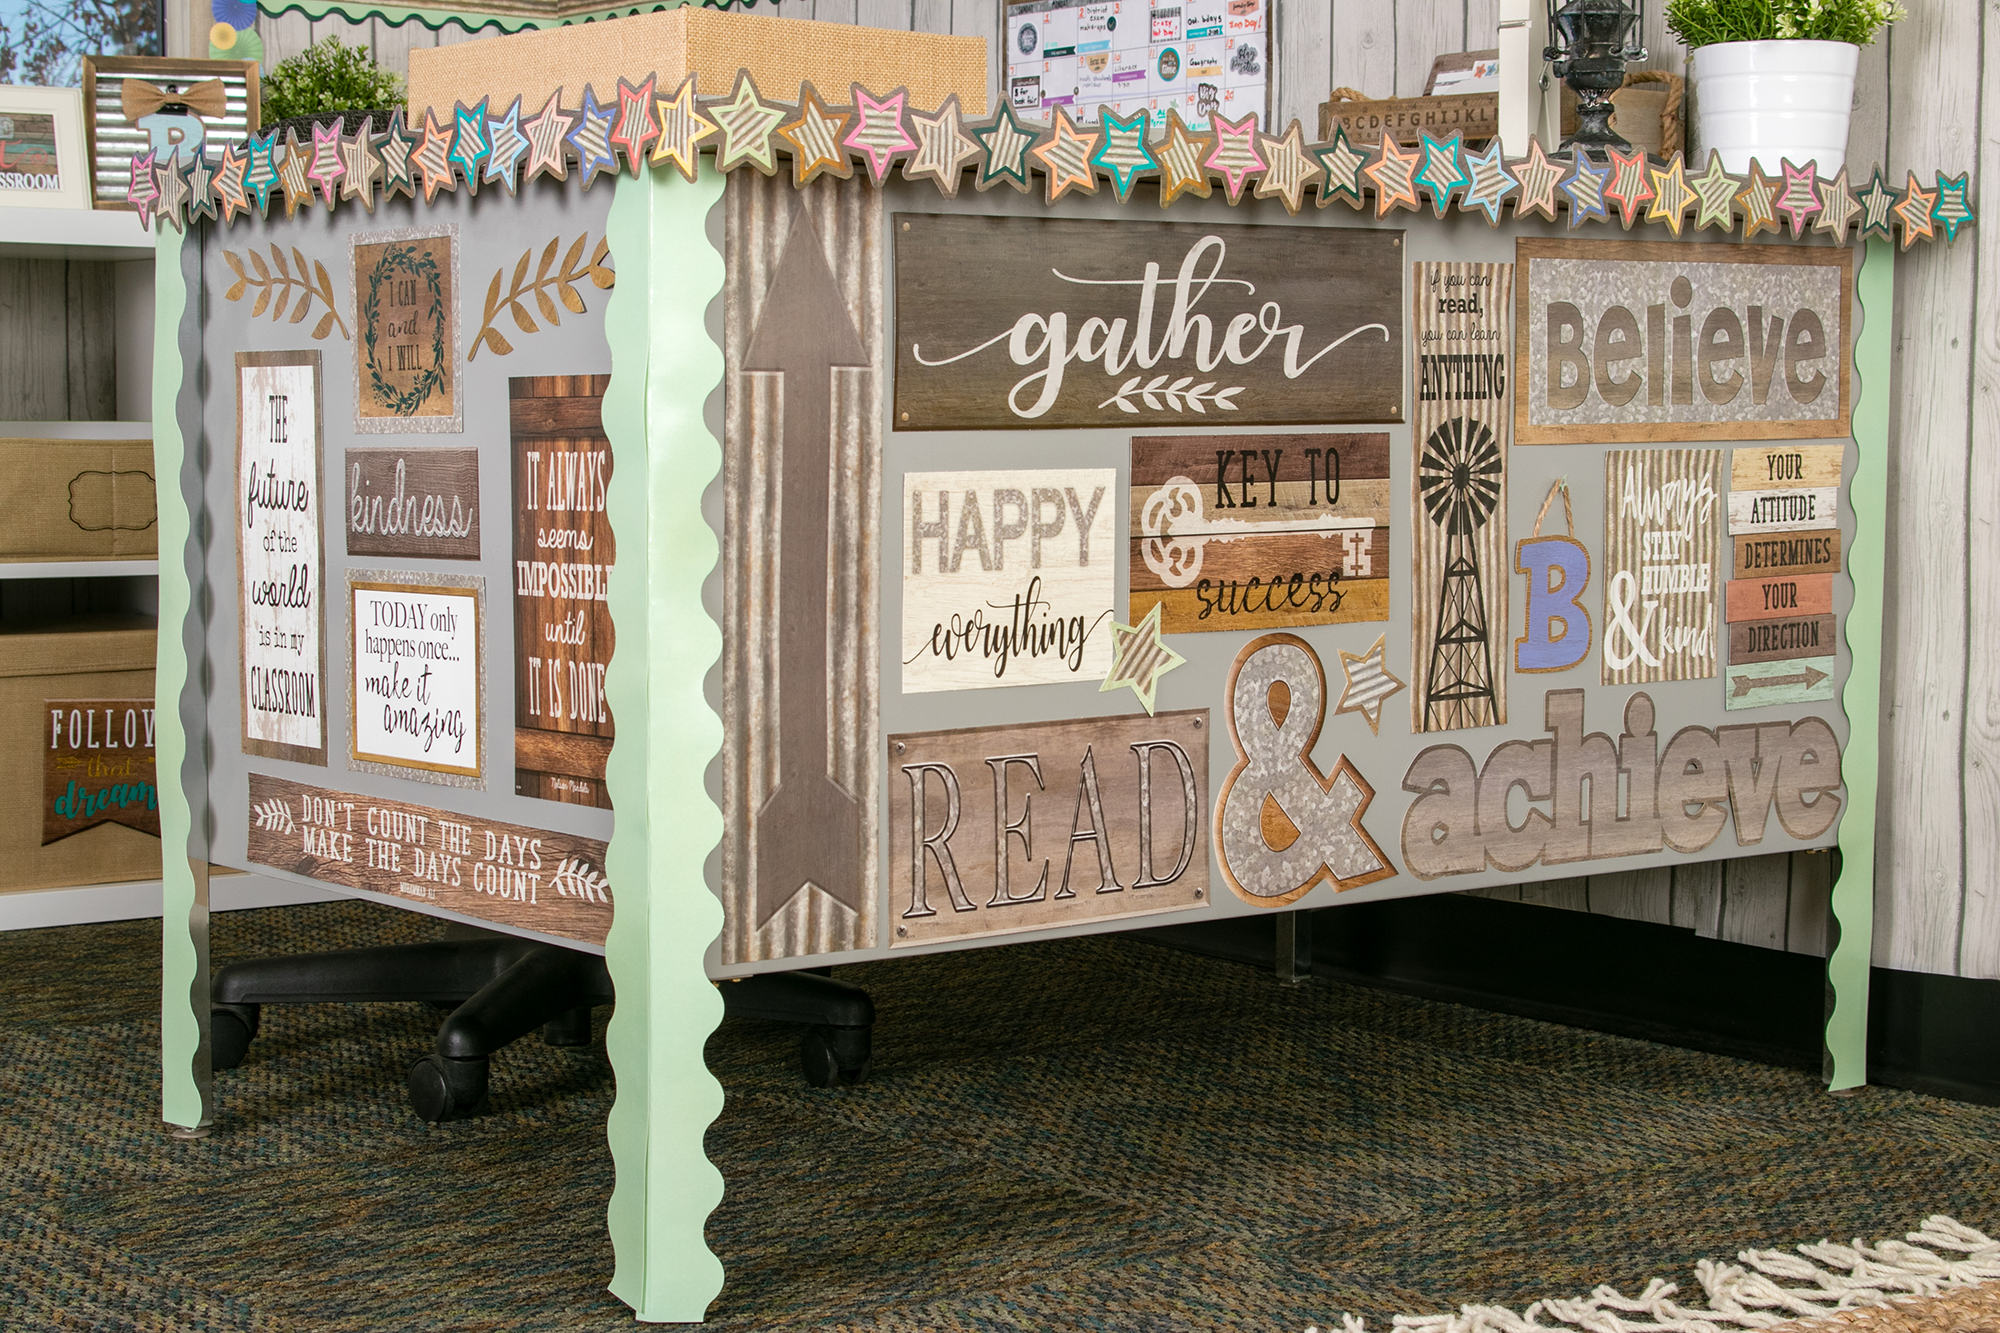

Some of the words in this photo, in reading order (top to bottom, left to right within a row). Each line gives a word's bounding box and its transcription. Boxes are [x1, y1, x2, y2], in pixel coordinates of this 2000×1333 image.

[1079, 7, 1085, 18] 2
[1114, 2, 1120, 14] 3
[389, 281, 394, 307] I
[398, 279, 417, 307] CAN
[1430, 269, 1441, 293] if
[1444, 275, 1466, 293] you
[1469, 275, 1492, 287] can
[388, 310, 421, 339] and
[914, 235, 1389, 418] gather
[1438, 293, 1484, 318] read,
[1422, 330, 1443, 347] you
[1446, 329, 1467, 341] can
[1470, 322, 1501, 341] learn
[1546, 275, 1828, 410] Believe
[388, 346, 392, 372] I
[397, 344, 422, 371] WILL
[1420, 353, 1505, 401] ANYTHING
[269, 395, 288, 443] THE
[527, 451, 540, 510] IT
[546, 450, 606, 512] ALWAYS
[1215, 449, 1283, 509] KEY
[1305, 447, 1340, 506] TO
[1766, 454, 1803, 481] YOUR
[248, 458, 309, 529] future
[351, 458, 473, 538] kindness
[1622, 462, 1718, 541] Always
[1750, 495, 1816, 524] ATTITUDE
[263, 530, 276, 552] of
[278, 531, 298, 553] the
[537, 527, 594, 551] seems
[912, 486, 1106, 574] HAPPY
[1642, 531, 1682, 561] STAY
[1744, 537, 1831, 570] DETERMINES
[252, 563, 311, 609] world
[1197, 572, 1348, 620] success
[1641, 563, 1711, 595] HUMBLE
[1762, 582, 1798, 610] YOUR
[370, 600, 429, 631] TODAY
[430, 606, 459, 641] only
[902, 575, 1114, 678] everything
[1514, 534, 1593, 674] B
[1603, 570, 1661, 671] &
[1661, 603, 1714, 659] kind
[259, 625, 271, 647] is
[274, 627, 287, 649] in
[291, 632, 305, 657] my
[365, 628, 416, 664] happens
[418, 640, 460, 662] once...
[545, 609, 586, 646] until
[1748, 621, 1820, 653] DIRECTION
[251, 665, 316, 718] CLASSROOM
[365, 661, 413, 700] make
[416, 664, 433, 706] it
[528, 656, 541, 716] IT
[548, 658, 562, 719] IS
[569, 660, 606, 724] DONE
[383, 703, 468, 754] amazing
[87, 753, 137, 778] that
[1401, 688, 1842, 881] achieve
[302, 794, 355, 832] DON'T
[367, 807, 429, 846] COUNT
[438, 820, 472, 856] THE
[484, 830, 542, 870] DAYS
[902, 739, 1198, 919] READ
[302, 825, 354, 863] MAKE
[365, 838, 402, 873] THE
[413, 847, 462, 887] DAYS
[474, 862, 541, 905] COUNT
